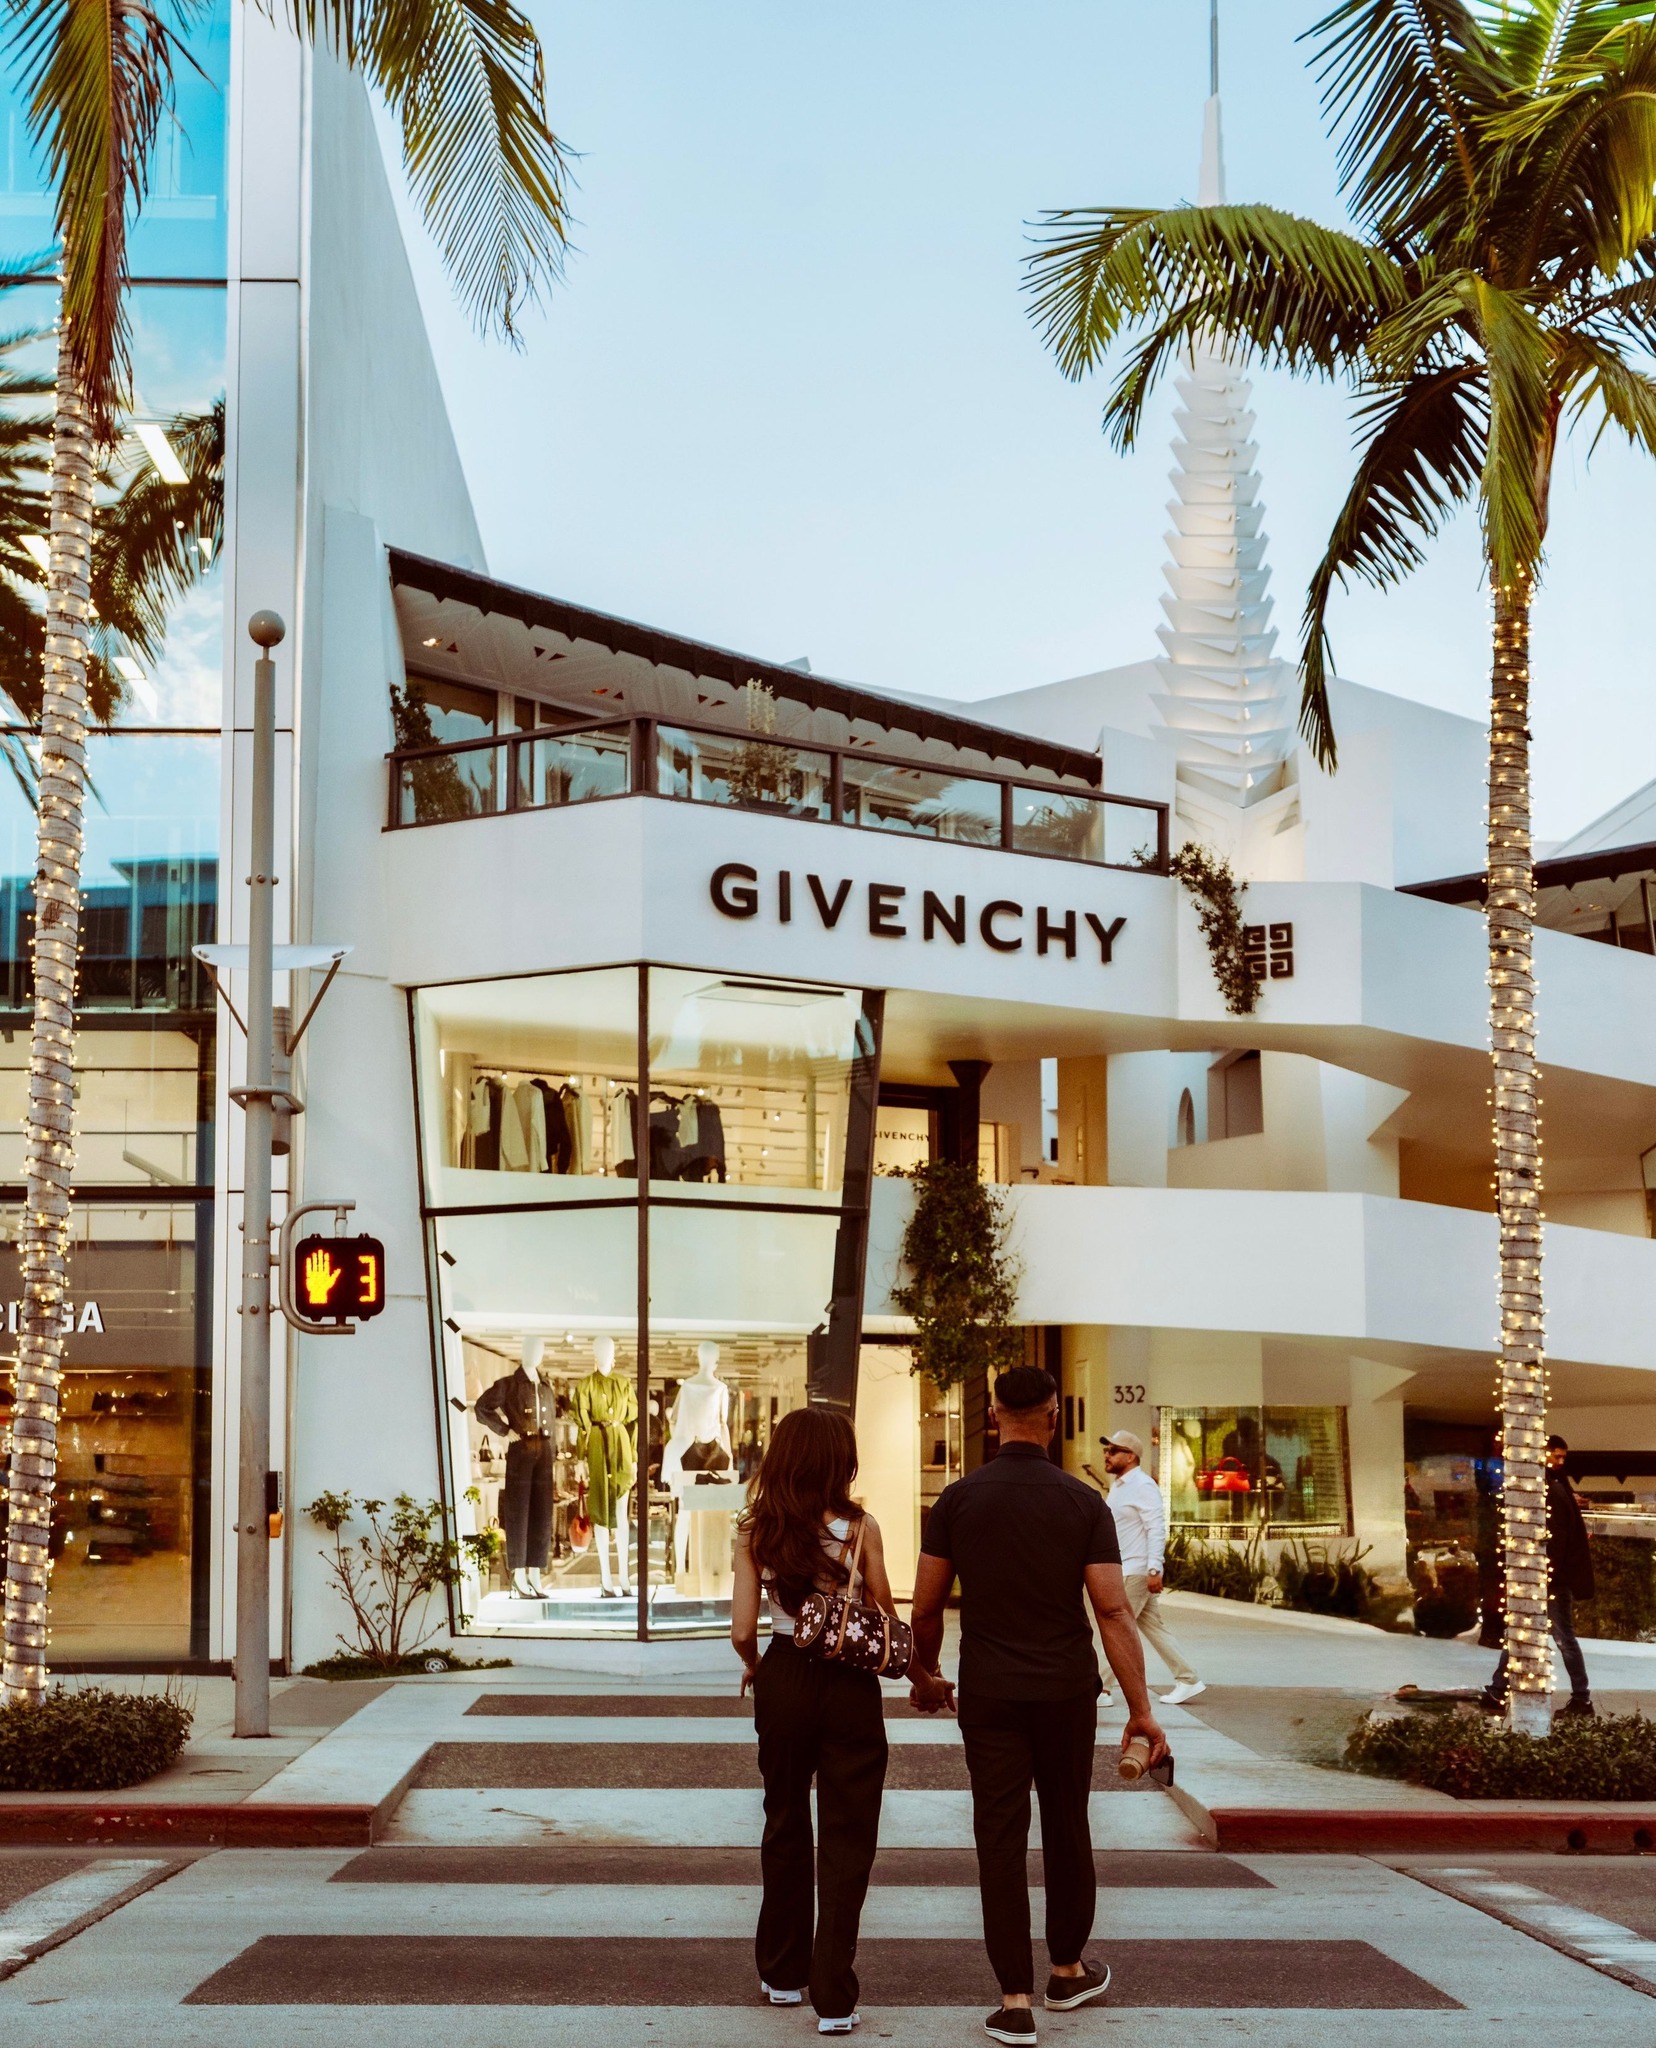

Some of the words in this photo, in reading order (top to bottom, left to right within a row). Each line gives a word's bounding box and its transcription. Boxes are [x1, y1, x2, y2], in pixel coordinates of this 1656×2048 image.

[710, 862, 1128, 964] GIVENCHY
[358, 1255, 376, 1303] 3
[1114, 1384, 1146, 1404] 332
